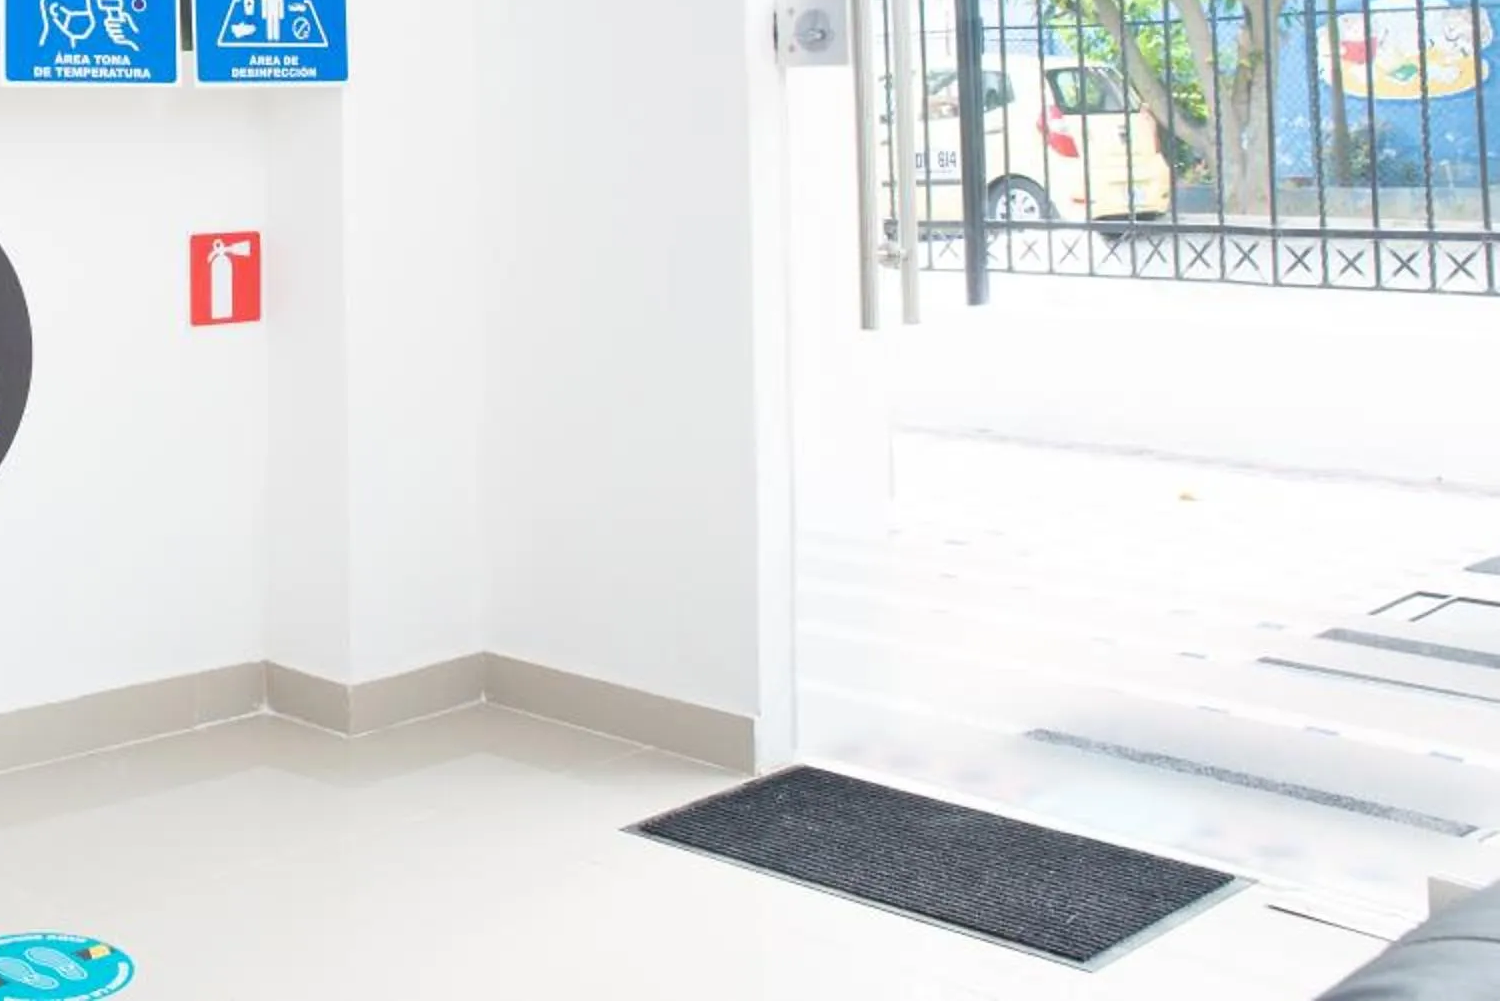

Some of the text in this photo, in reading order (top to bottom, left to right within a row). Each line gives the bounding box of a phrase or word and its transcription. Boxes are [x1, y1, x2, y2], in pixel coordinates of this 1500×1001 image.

[93, 54, 131, 66] TOMA
[283, 54, 299, 66] DE
[33, 65, 151, 80] DE TEMPERATURA
